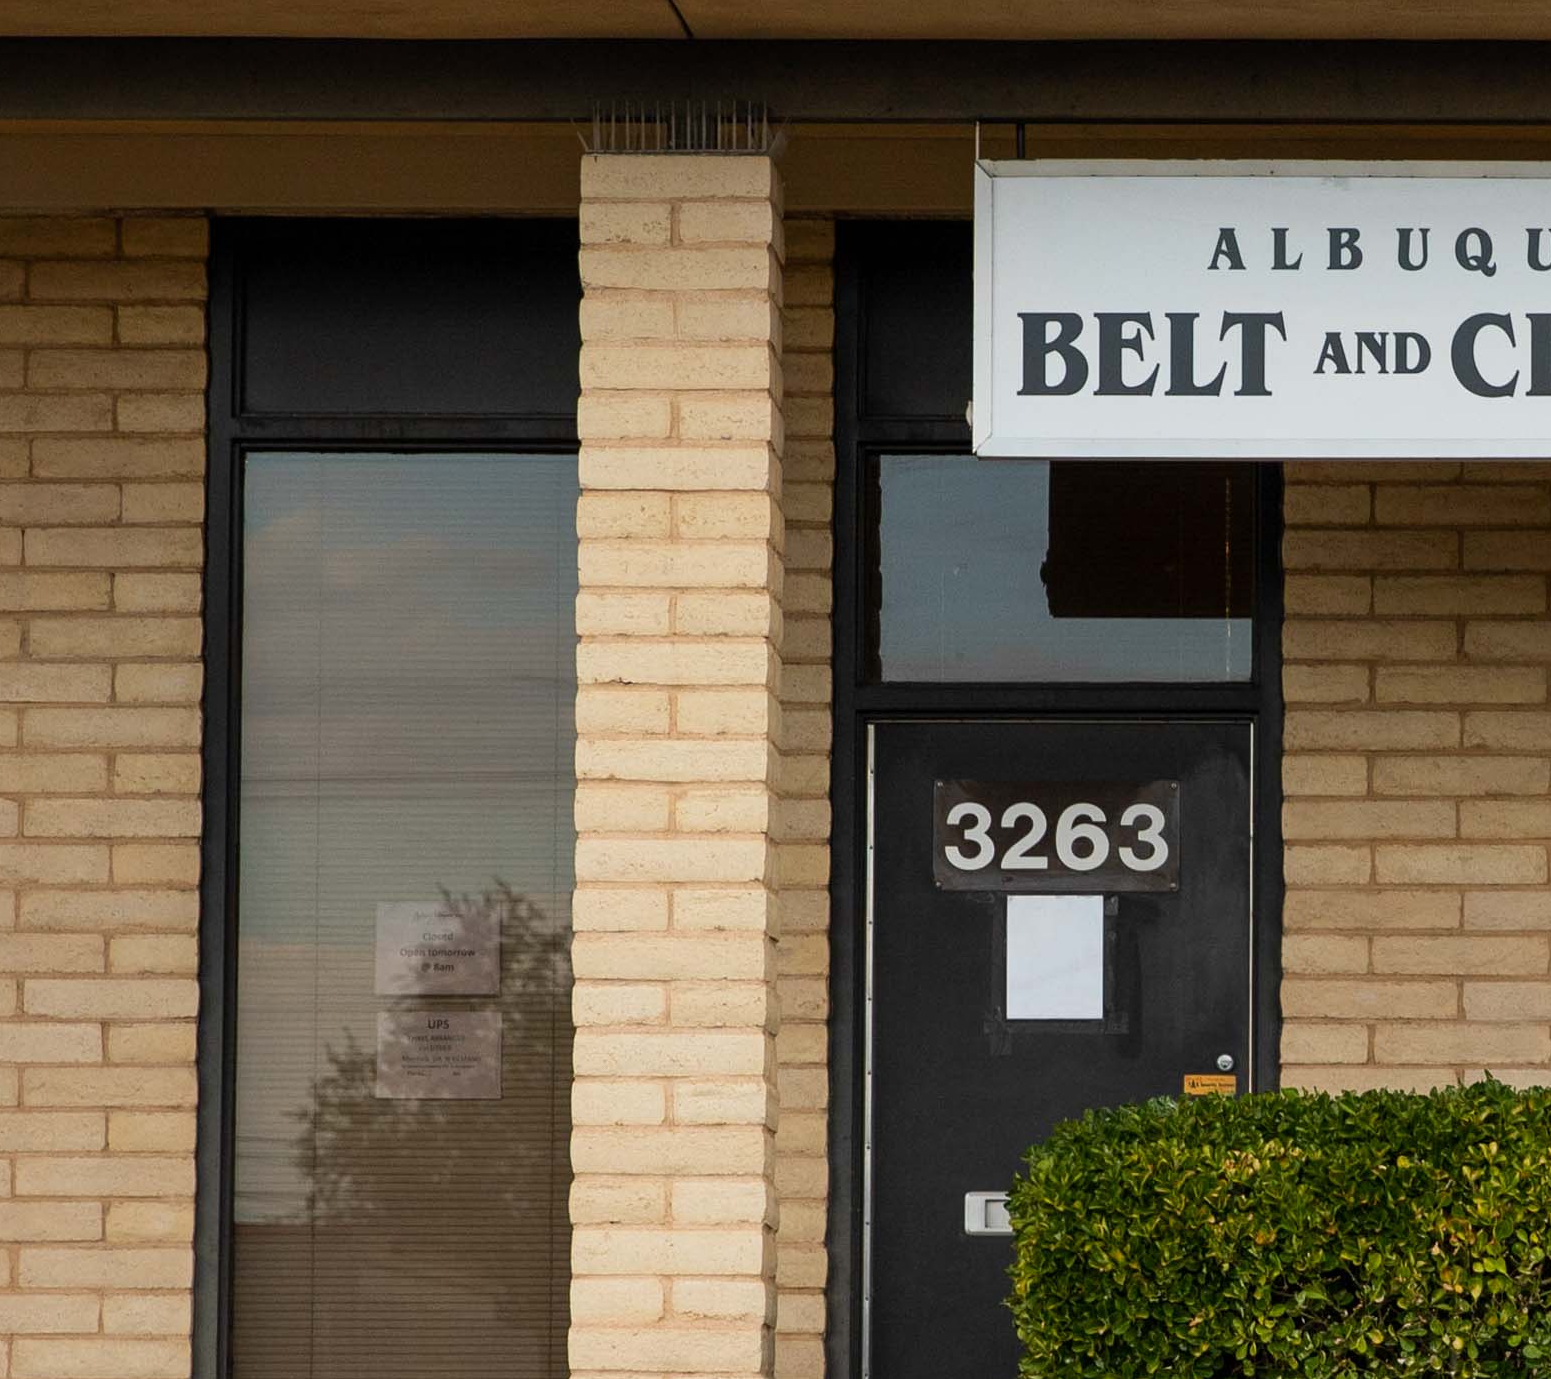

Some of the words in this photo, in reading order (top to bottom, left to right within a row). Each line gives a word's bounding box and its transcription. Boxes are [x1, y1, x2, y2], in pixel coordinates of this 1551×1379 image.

[1017, 311, 1287, 397] BELT
[1313, 332, 1431, 374] AND
[945, 803, 1168, 871] 3263
[427, 1018, 450, 1030] UPS
